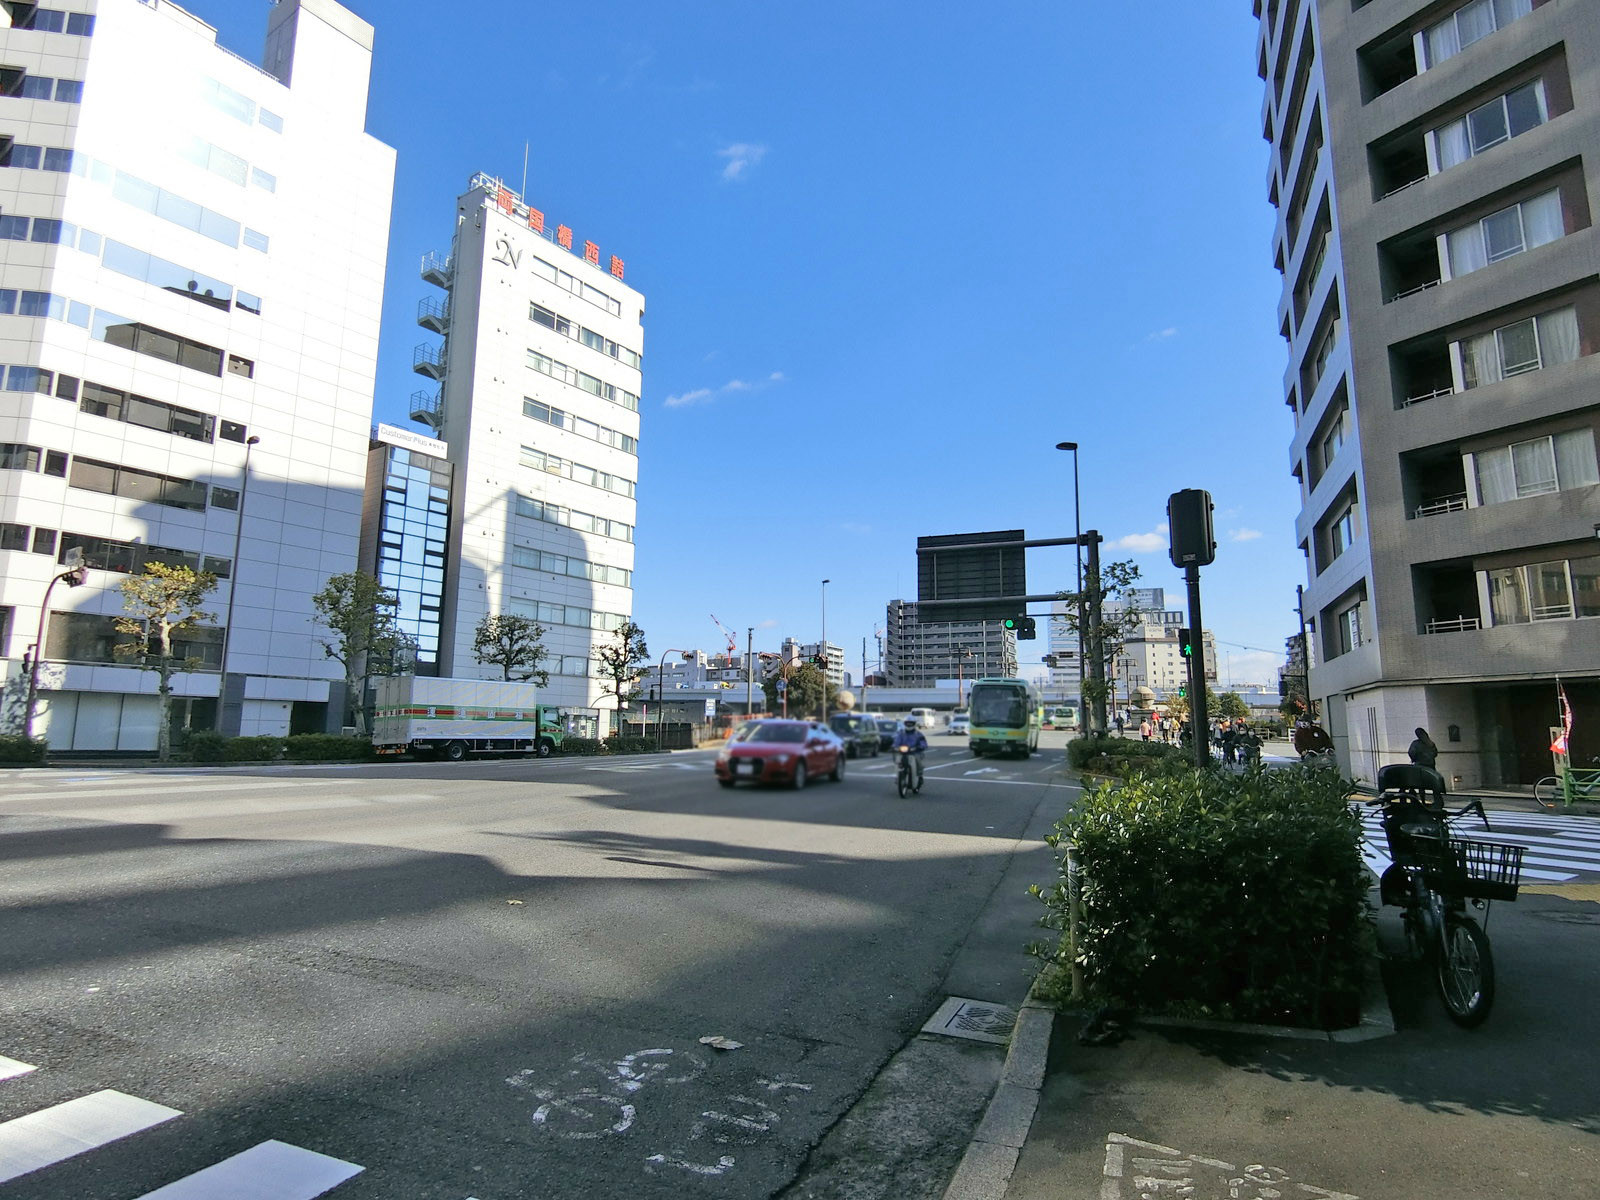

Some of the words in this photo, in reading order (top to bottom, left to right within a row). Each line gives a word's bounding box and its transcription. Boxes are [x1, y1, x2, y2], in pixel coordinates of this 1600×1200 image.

[497, 187, 625, 280] 両国橋西詰
[381, 427, 412, 441] Customer
